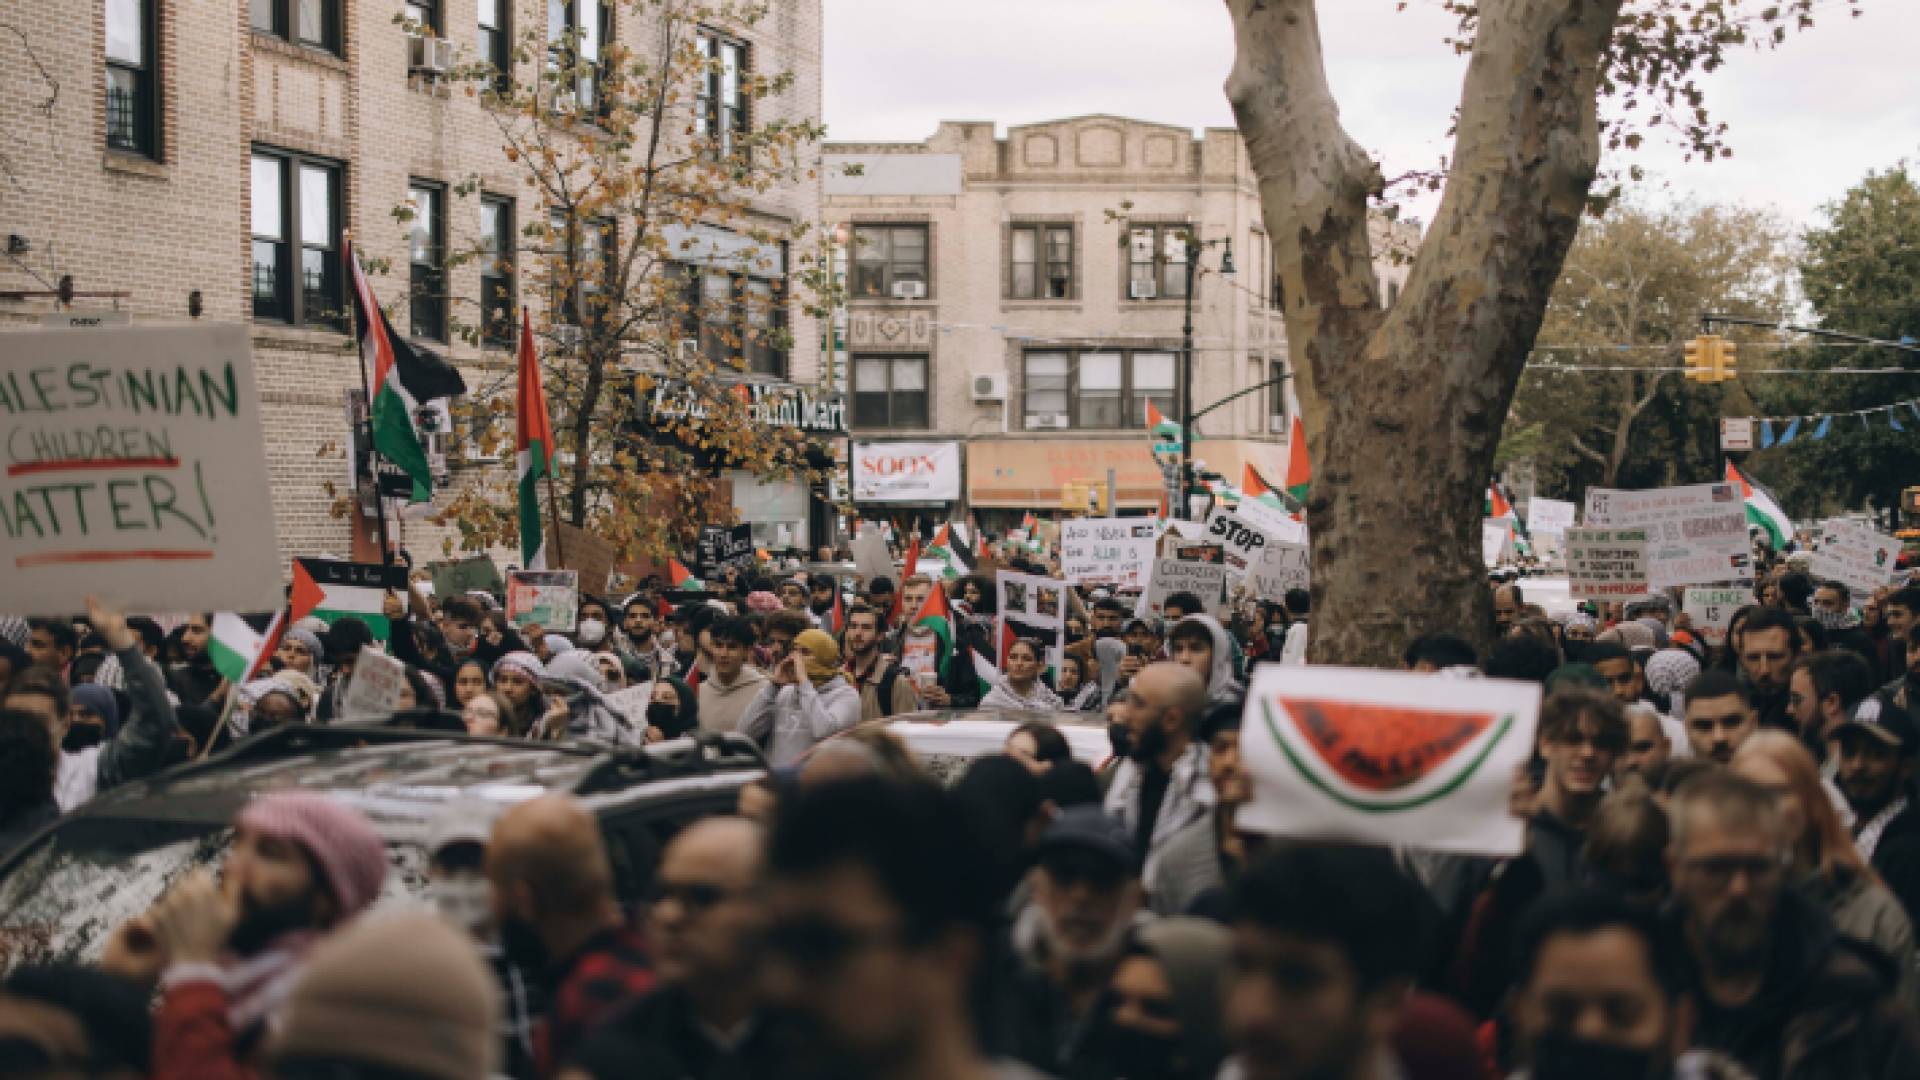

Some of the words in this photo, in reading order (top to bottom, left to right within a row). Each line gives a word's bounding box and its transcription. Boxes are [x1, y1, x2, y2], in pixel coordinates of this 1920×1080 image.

[8, 424, 175, 463] CHILDREN
[862, 454, 936, 476] SOON
[0, 459, 218, 543] ATTER!
[1209, 515, 1264, 553] STOP
[1690, 591, 1744, 606] SILENCE
[1705, 607, 1720, 621] IS
